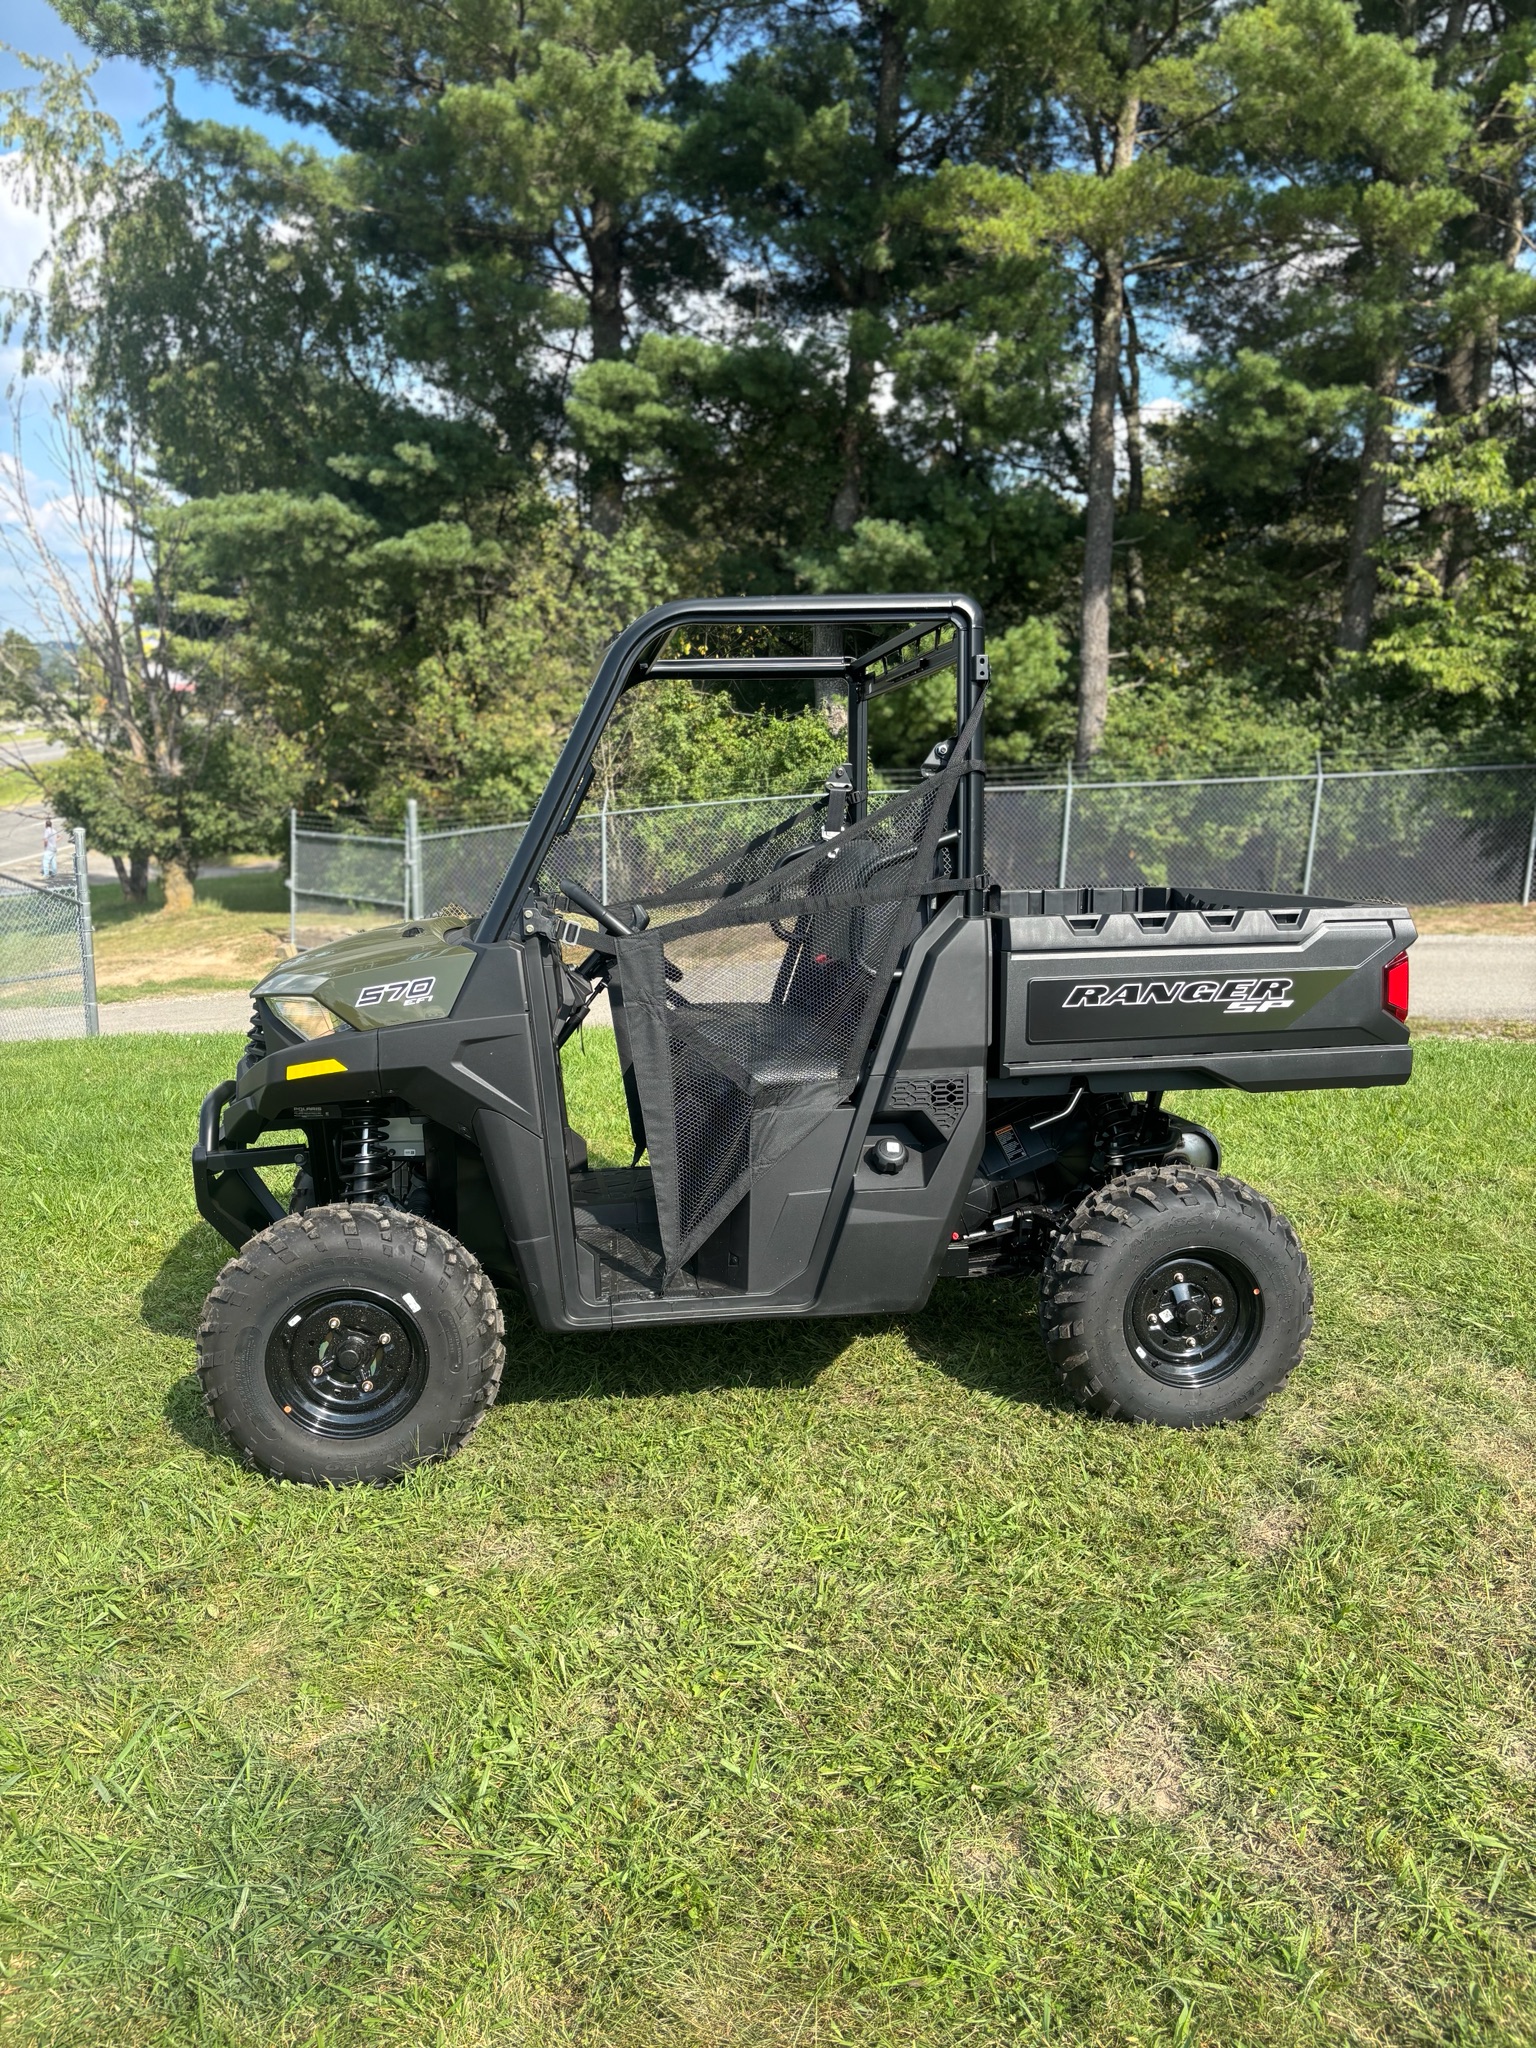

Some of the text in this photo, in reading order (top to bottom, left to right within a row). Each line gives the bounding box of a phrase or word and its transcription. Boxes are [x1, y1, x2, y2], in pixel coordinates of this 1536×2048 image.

[355, 976, 436, 1008] 570
[1061, 978, 1293, 1008] RANGER
[1223, 1000, 1294, 1014] SP
